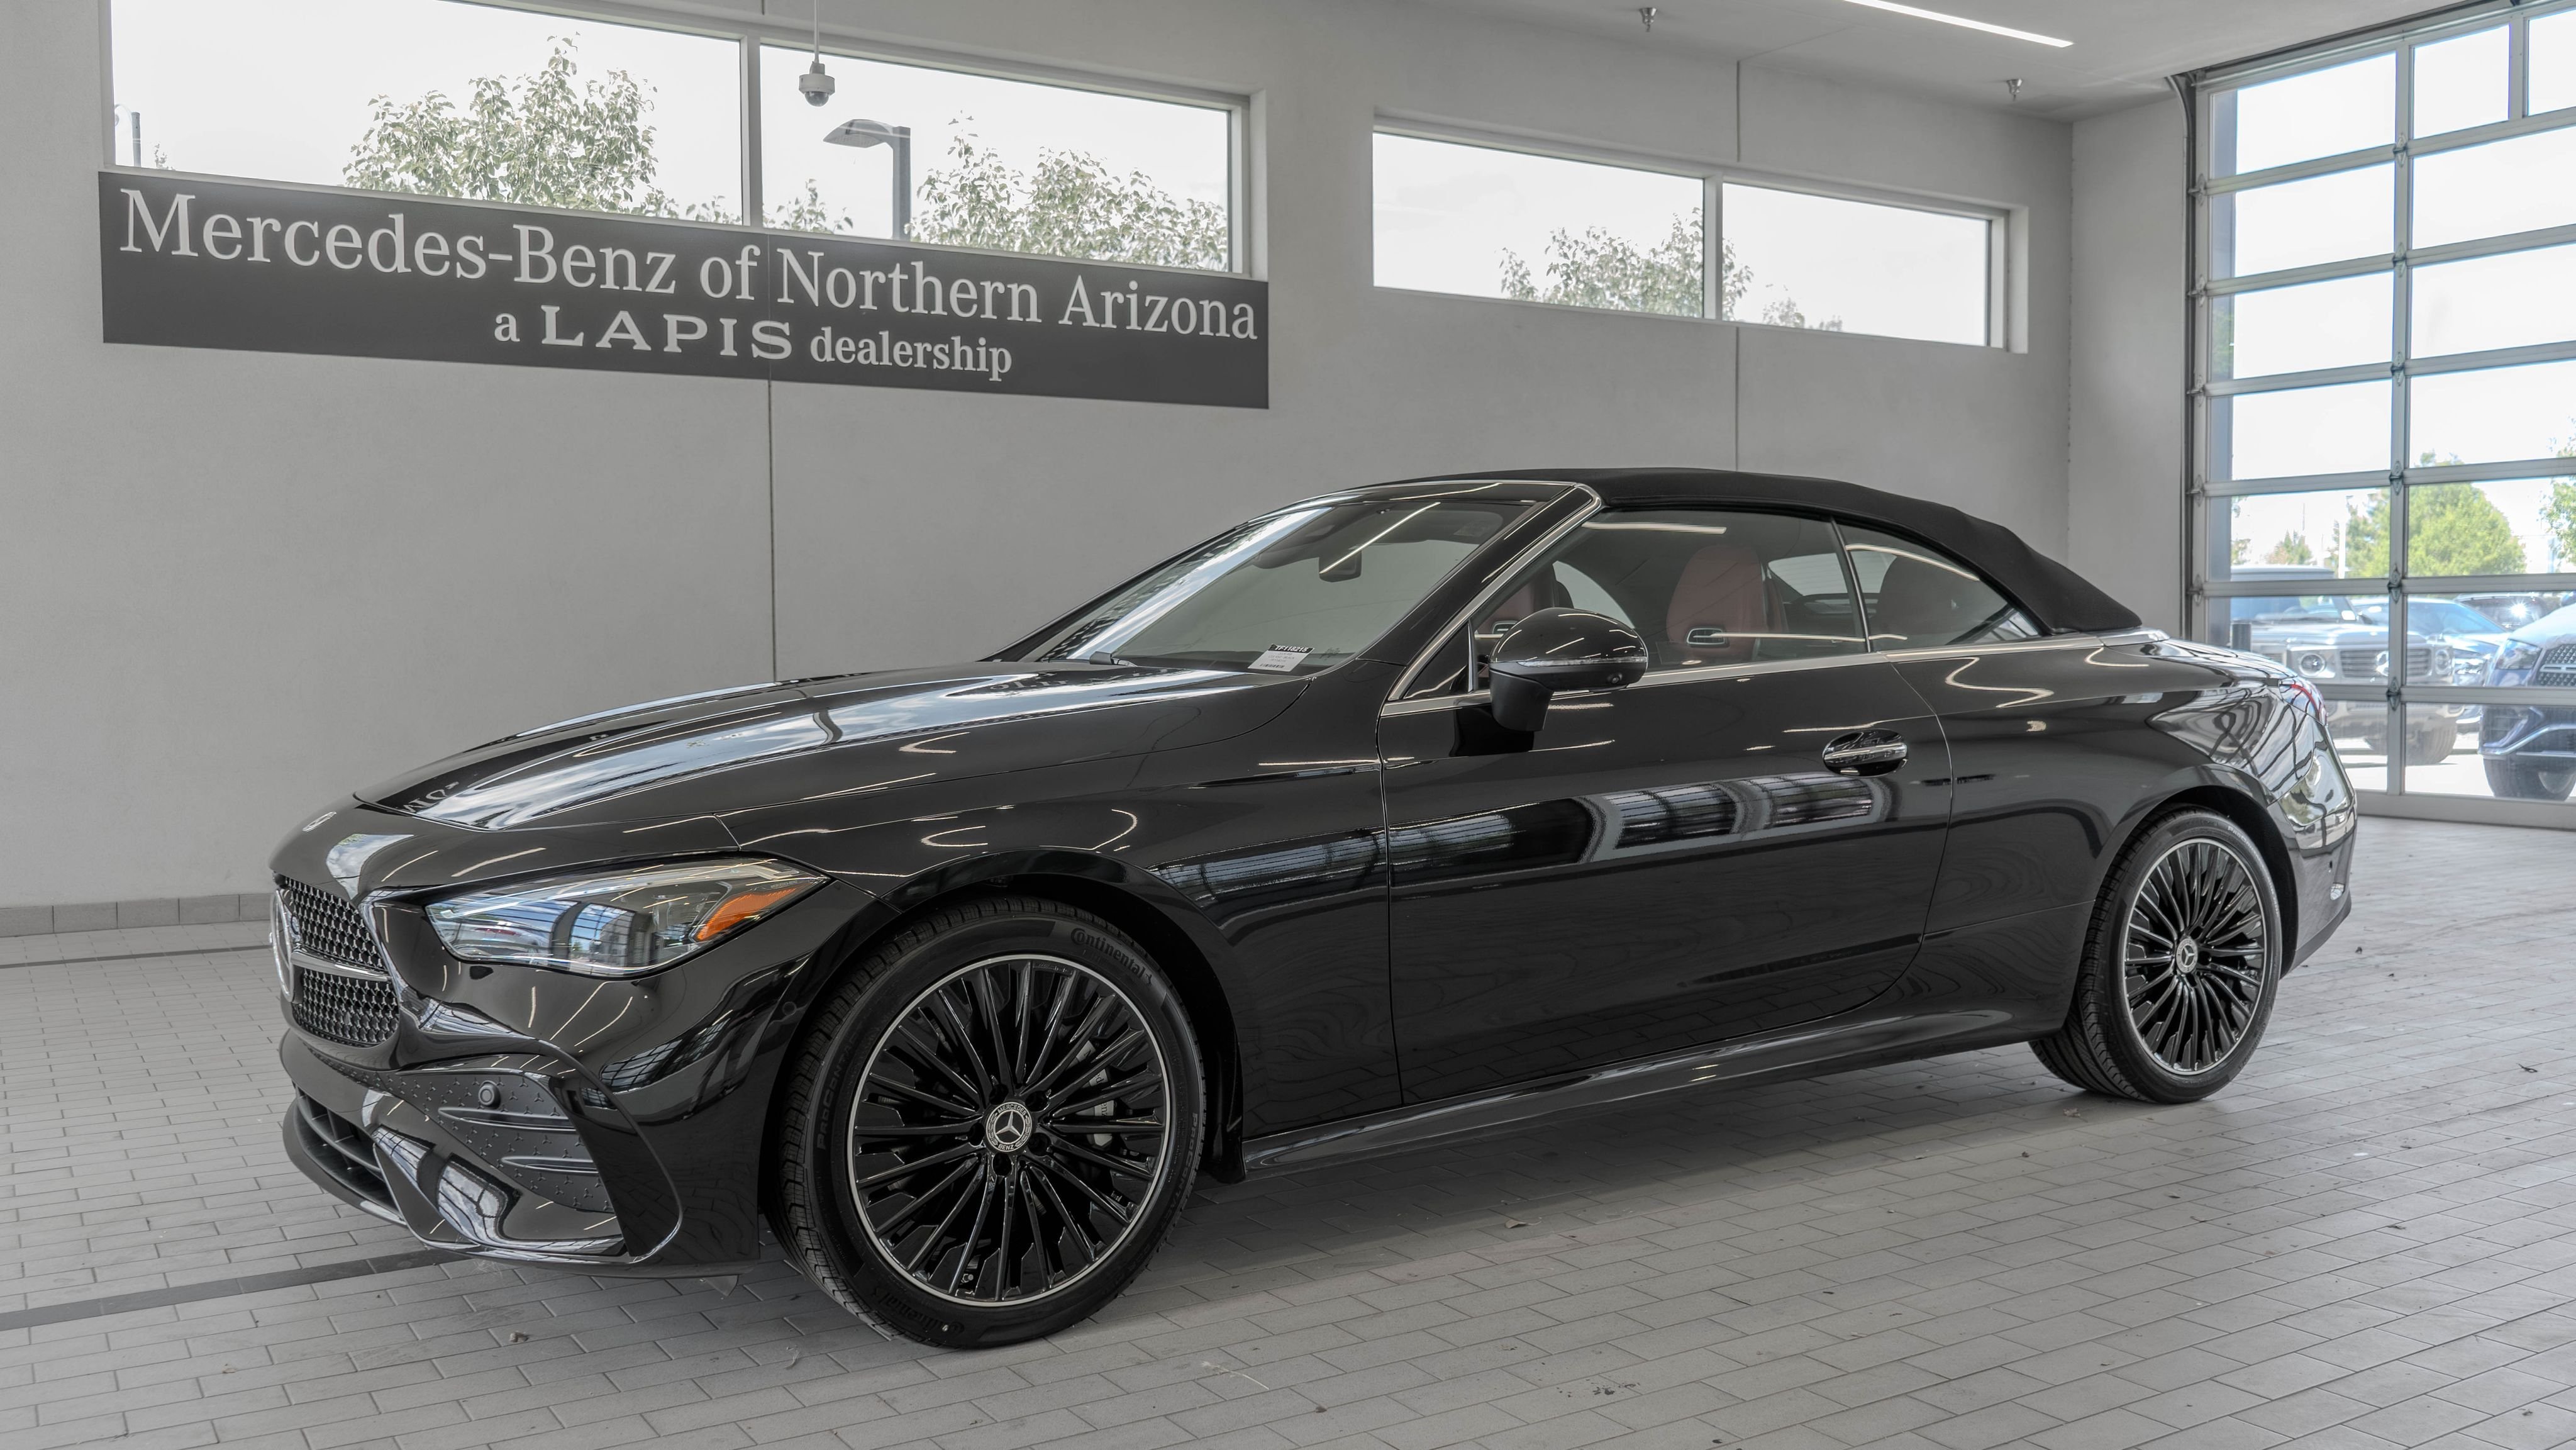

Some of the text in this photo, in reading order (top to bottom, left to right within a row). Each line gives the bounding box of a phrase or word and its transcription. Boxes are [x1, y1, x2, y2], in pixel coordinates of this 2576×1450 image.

[119, 188, 1258, 340] Mercedes-Benz of Northern Arizona
[494, 305, 1013, 382] a LAPIS dealership
[1070, 927, 1146, 978] Continental
[997, 1104, 1027, 1117] MERCEDES
